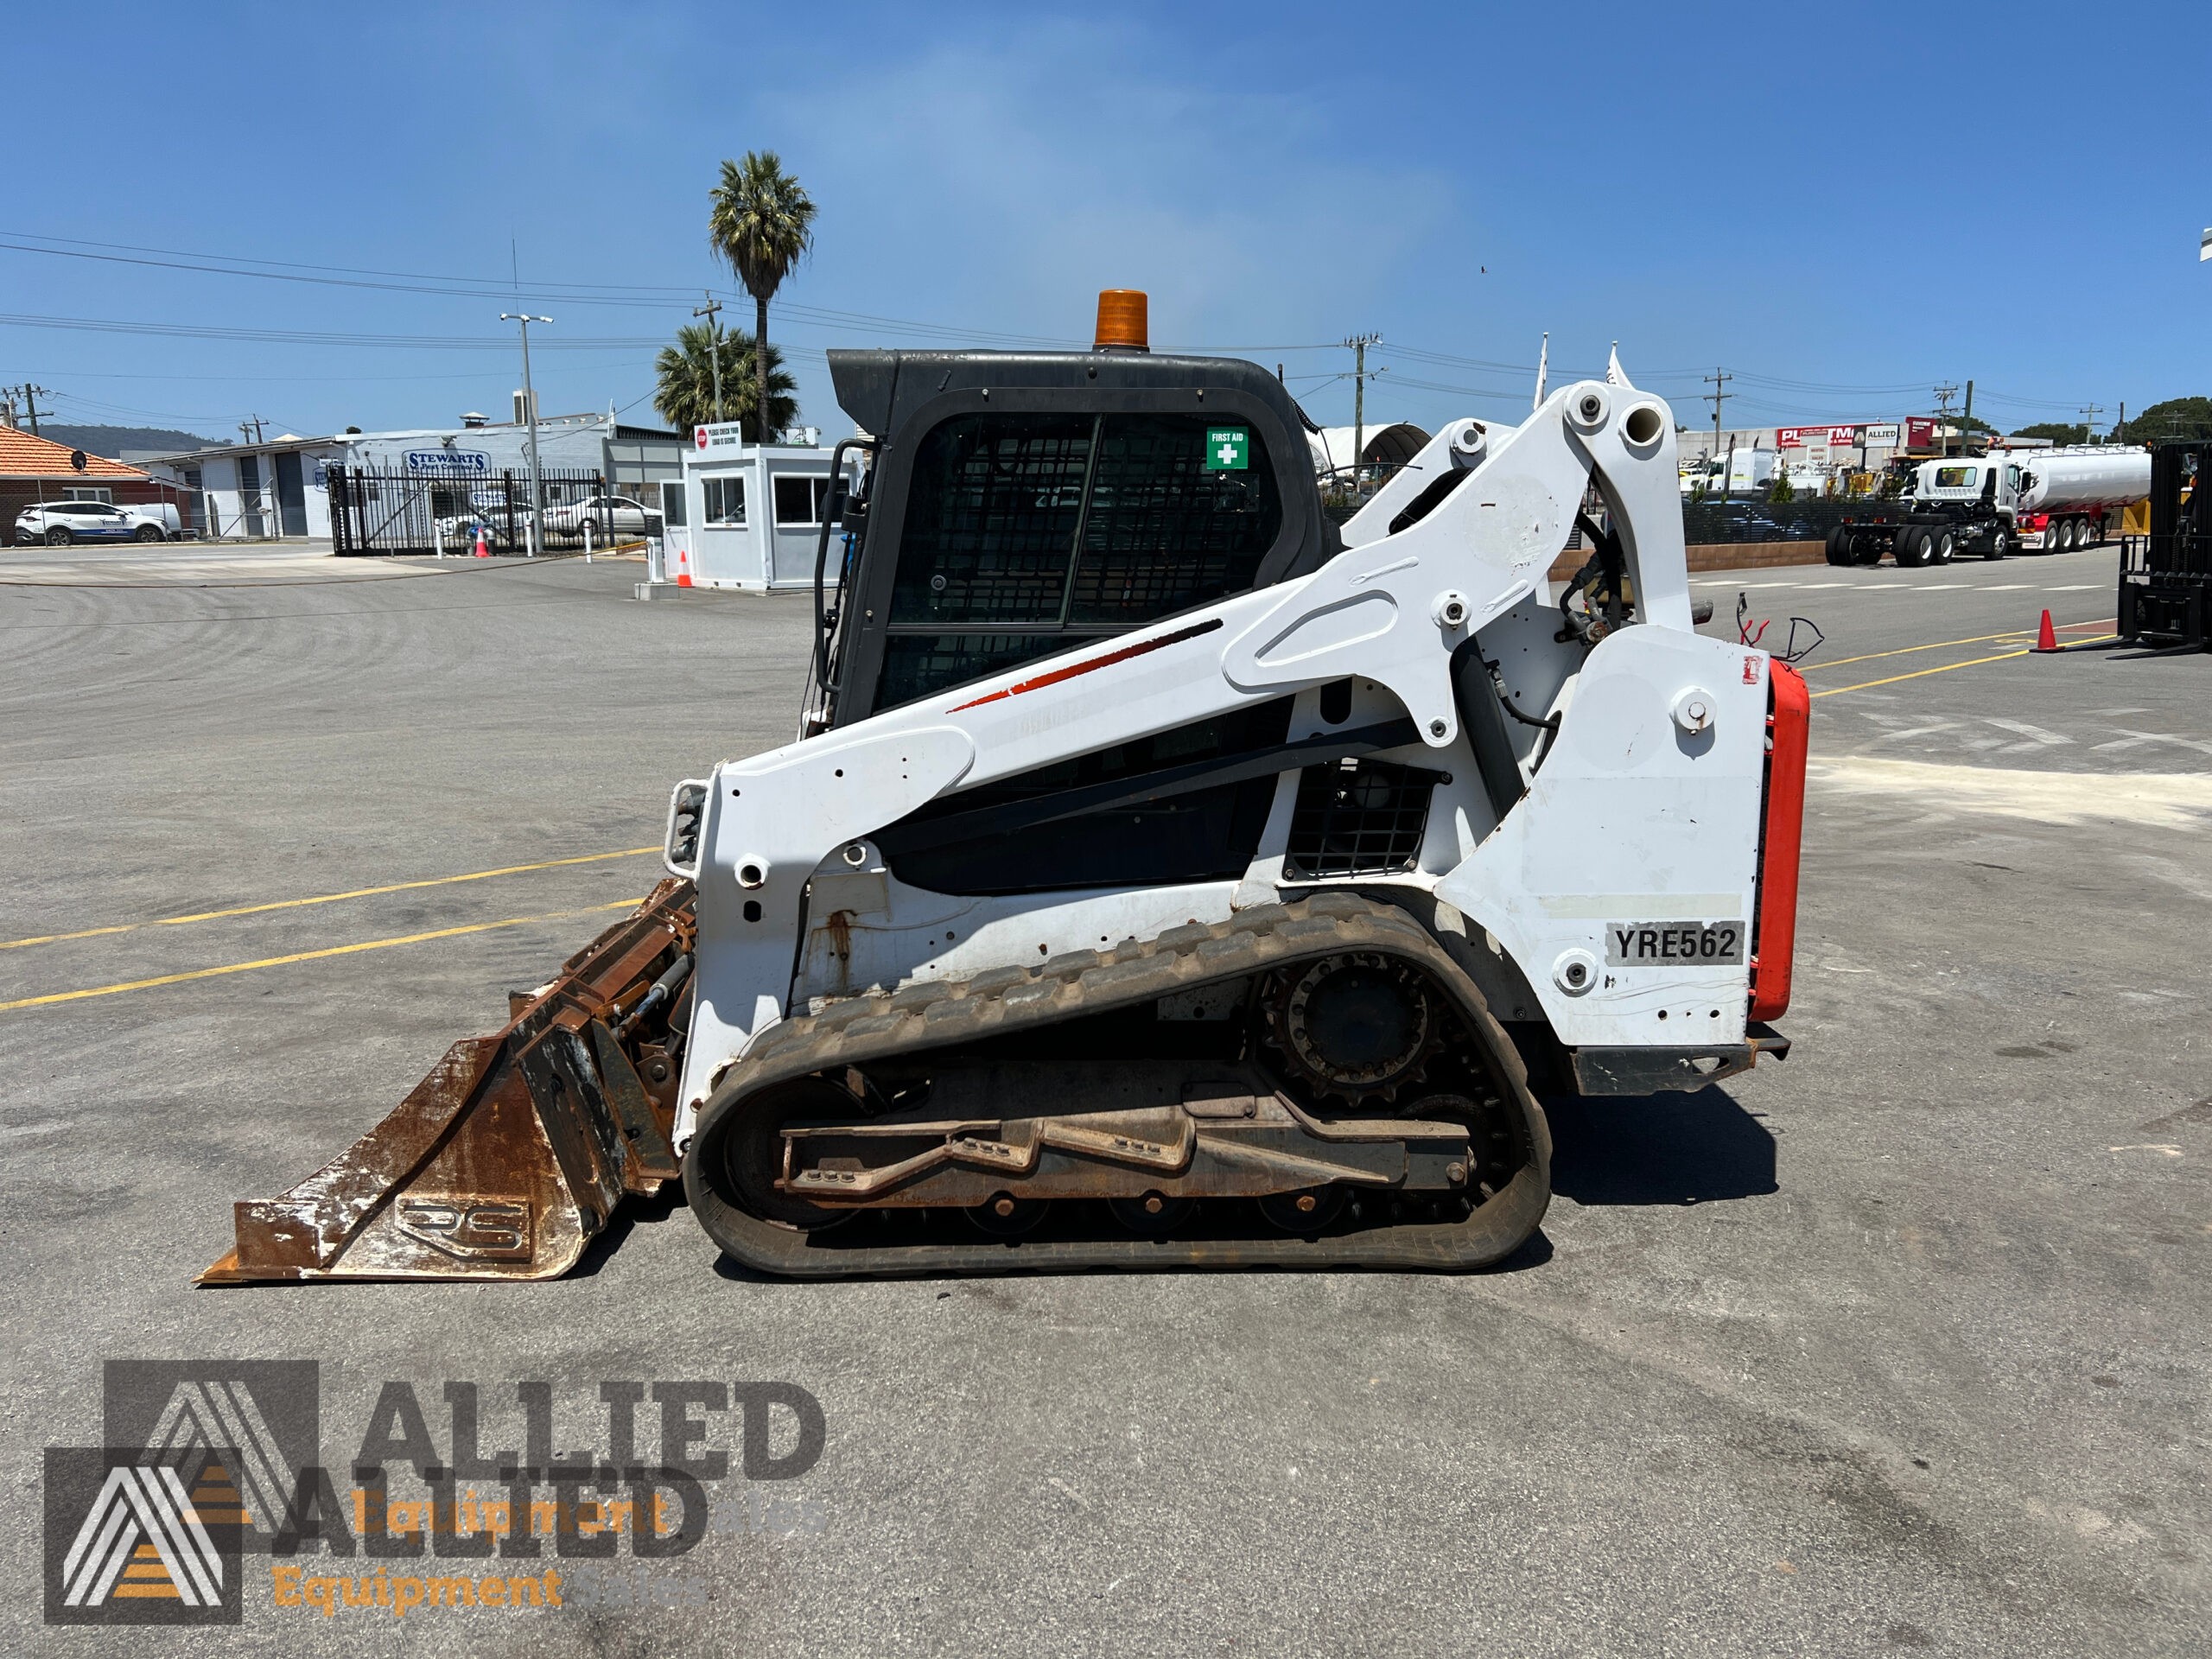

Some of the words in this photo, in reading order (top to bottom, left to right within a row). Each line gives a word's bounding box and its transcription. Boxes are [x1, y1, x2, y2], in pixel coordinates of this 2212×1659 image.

[1211, 433, 1230, 442] FIRST
[1231, 433, 1243, 442] AID
[409, 453, 485, 470] STEWARTS
[1615, 929, 1737, 958] YRE562
